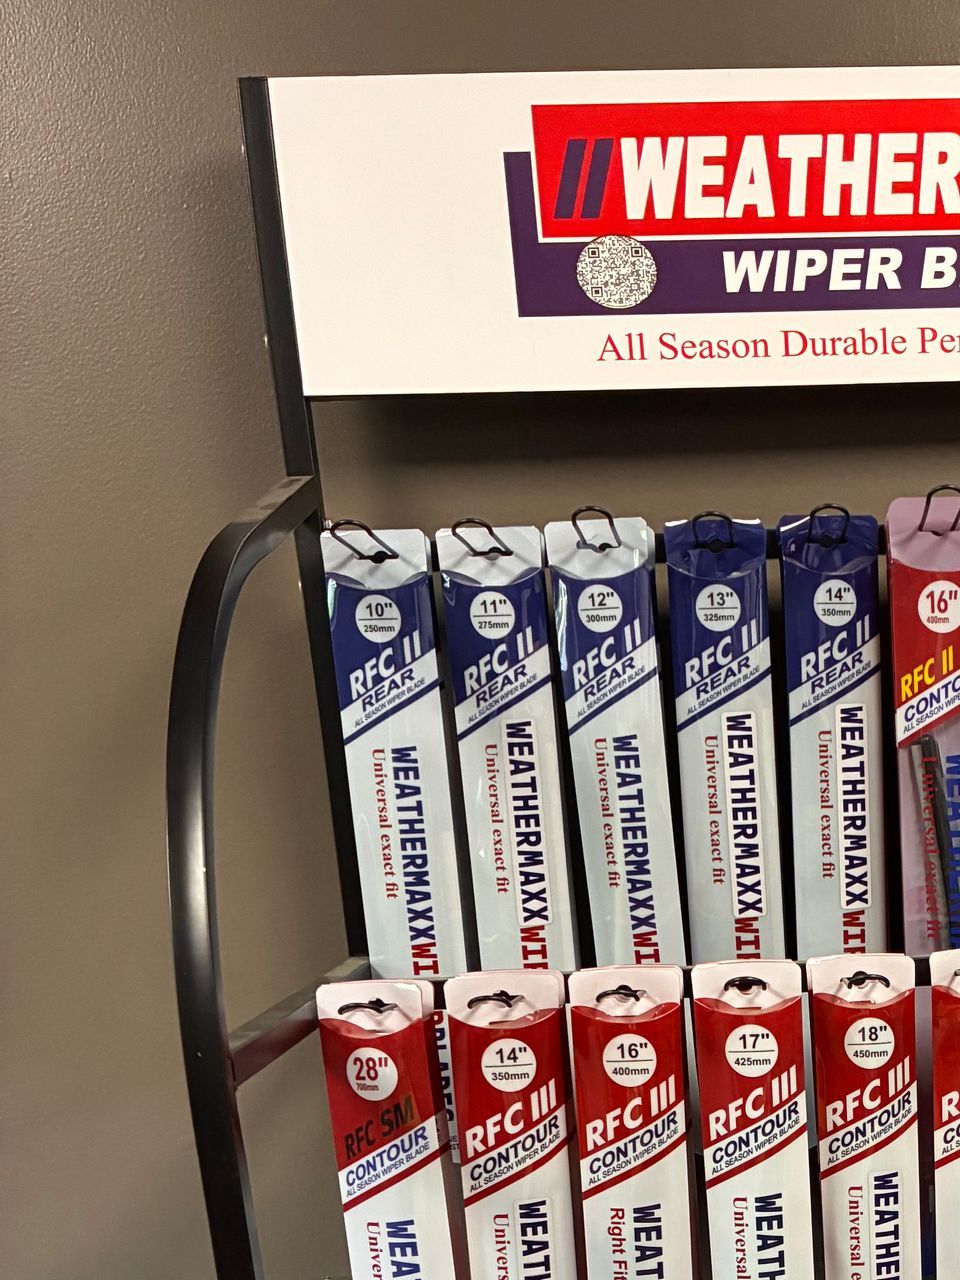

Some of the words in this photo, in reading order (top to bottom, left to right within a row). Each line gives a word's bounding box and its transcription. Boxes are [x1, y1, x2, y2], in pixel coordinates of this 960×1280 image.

[722, 248, 903, 293] WIPER
[598, 331, 645, 363] All
[659, 330, 771, 361] Season
[782, 328, 908, 359] Durable
[481, 599, 506, 613] 11"
[588, 591, 614, 606] 12"
[708, 592, 733, 606] 13"
[826, 587, 850, 601] 14"
[926, 590, 958, 613] 16"
[366, 602, 392, 617] 10"
[586, 614, 616, 622] 300mm
[704, 613, 734, 621] 325mm
[822, 608, 850, 616] 350mm
[478, 621, 509, 629] 275mm
[801, 631, 848, 683] RFC
[856, 614, 869, 648] II
[350, 647, 395, 701] RFC
[403, 629, 421, 664] II
[584, 657, 636, 702] REAR
[696, 657, 751, 700] REAR
[811, 651, 863, 694] REAR
[901, 658, 935, 702] RFC
[941, 646, 953, 675] II
[362, 668, 415, 712] REAR
[476, 664, 528, 708] REAR
[485, 744, 504, 823] Universal
[493, 829, 505, 871] exact
[496, 877, 510, 893] fit
[739, 1033, 769, 1049] 17"
[858, 1025, 887, 1041] 18"
[496, 1046, 526, 1063] 14"
[617, 1042, 647, 1058] 16"
[735, 1058, 770, 1066] 425mm
[853, 1050, 888, 1058] 450mm
[353, 1057, 387, 1081] 28"
[492, 1072, 529, 1080] 350mm
[612, 1067, 649, 1075] 400mm
[709, 1087, 764, 1141] RFC
[772, 1064, 797, 1107] III
[465, 1102, 524, 1159] RFC
[531, 1078, 556, 1122] III
[712, 1101, 799, 1164] CONTOUR
[828, 1091, 912, 1154] CONTOUR
[346, 1127, 428, 1186] CONTOUR
[470, 1115, 560, 1182] CONTOUR
[589, 1111, 679, 1175] CONTOUR
[712, 1164, 724, 1175] ALL
[725, 1149, 753, 1168] SEASON
[755, 1133, 778, 1152] WIPER
[780, 1116, 800, 1137] BLADE
[608, 1208, 626, 1254] Right
[613, 1260, 627, 1280] Fit
